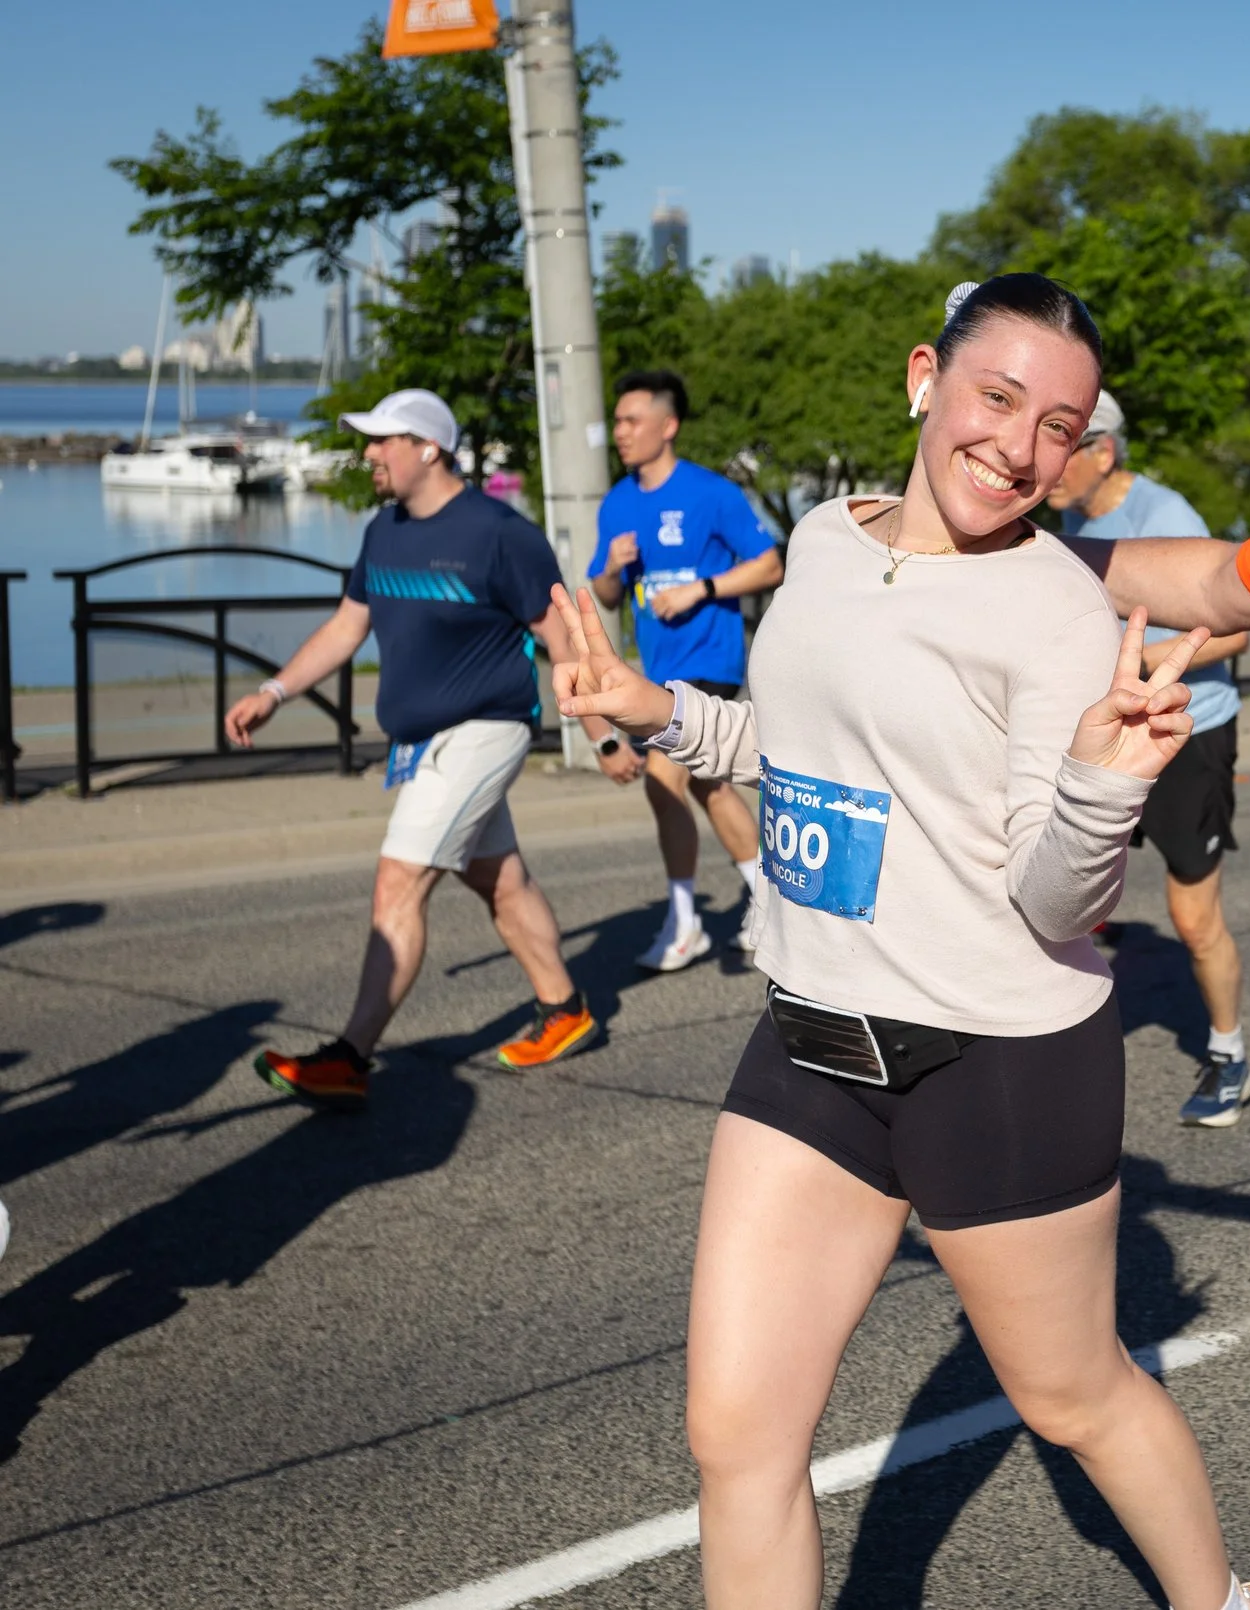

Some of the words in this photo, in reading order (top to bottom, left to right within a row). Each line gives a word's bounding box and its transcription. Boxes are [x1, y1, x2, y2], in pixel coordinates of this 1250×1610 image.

[766, 779, 782, 799] TOR
[795, 791, 822, 809] 10K
[773, 774, 790, 785] UNDER
[790, 780, 817, 792] ARMOUR
[764, 803, 829, 871] 500
[771, 860, 807, 889] NICOLE
